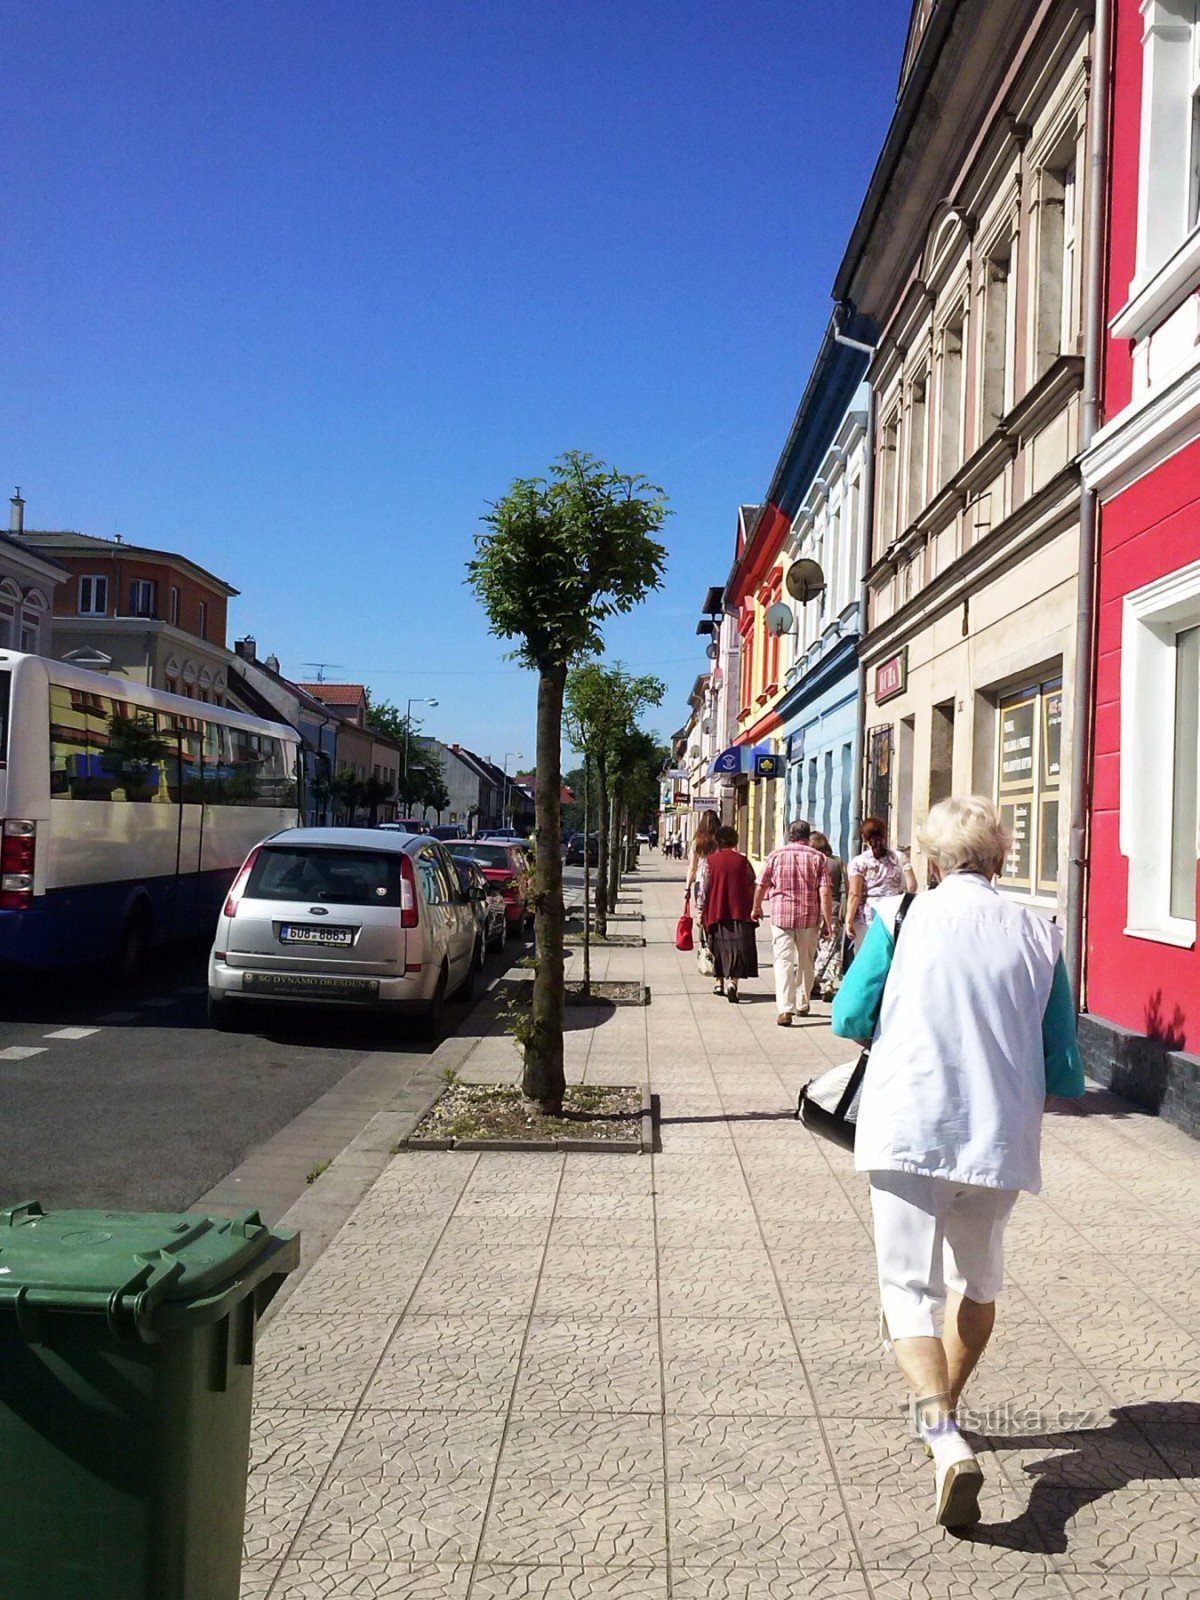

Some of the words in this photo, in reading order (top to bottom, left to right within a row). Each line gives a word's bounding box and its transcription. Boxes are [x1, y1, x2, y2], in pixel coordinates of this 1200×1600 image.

[290, 927, 311, 939] 6U8
[319, 929, 347, 941] 8863
[273, 976, 317, 985] DYNAMO
[319, 978, 366, 988] DRESDEN
